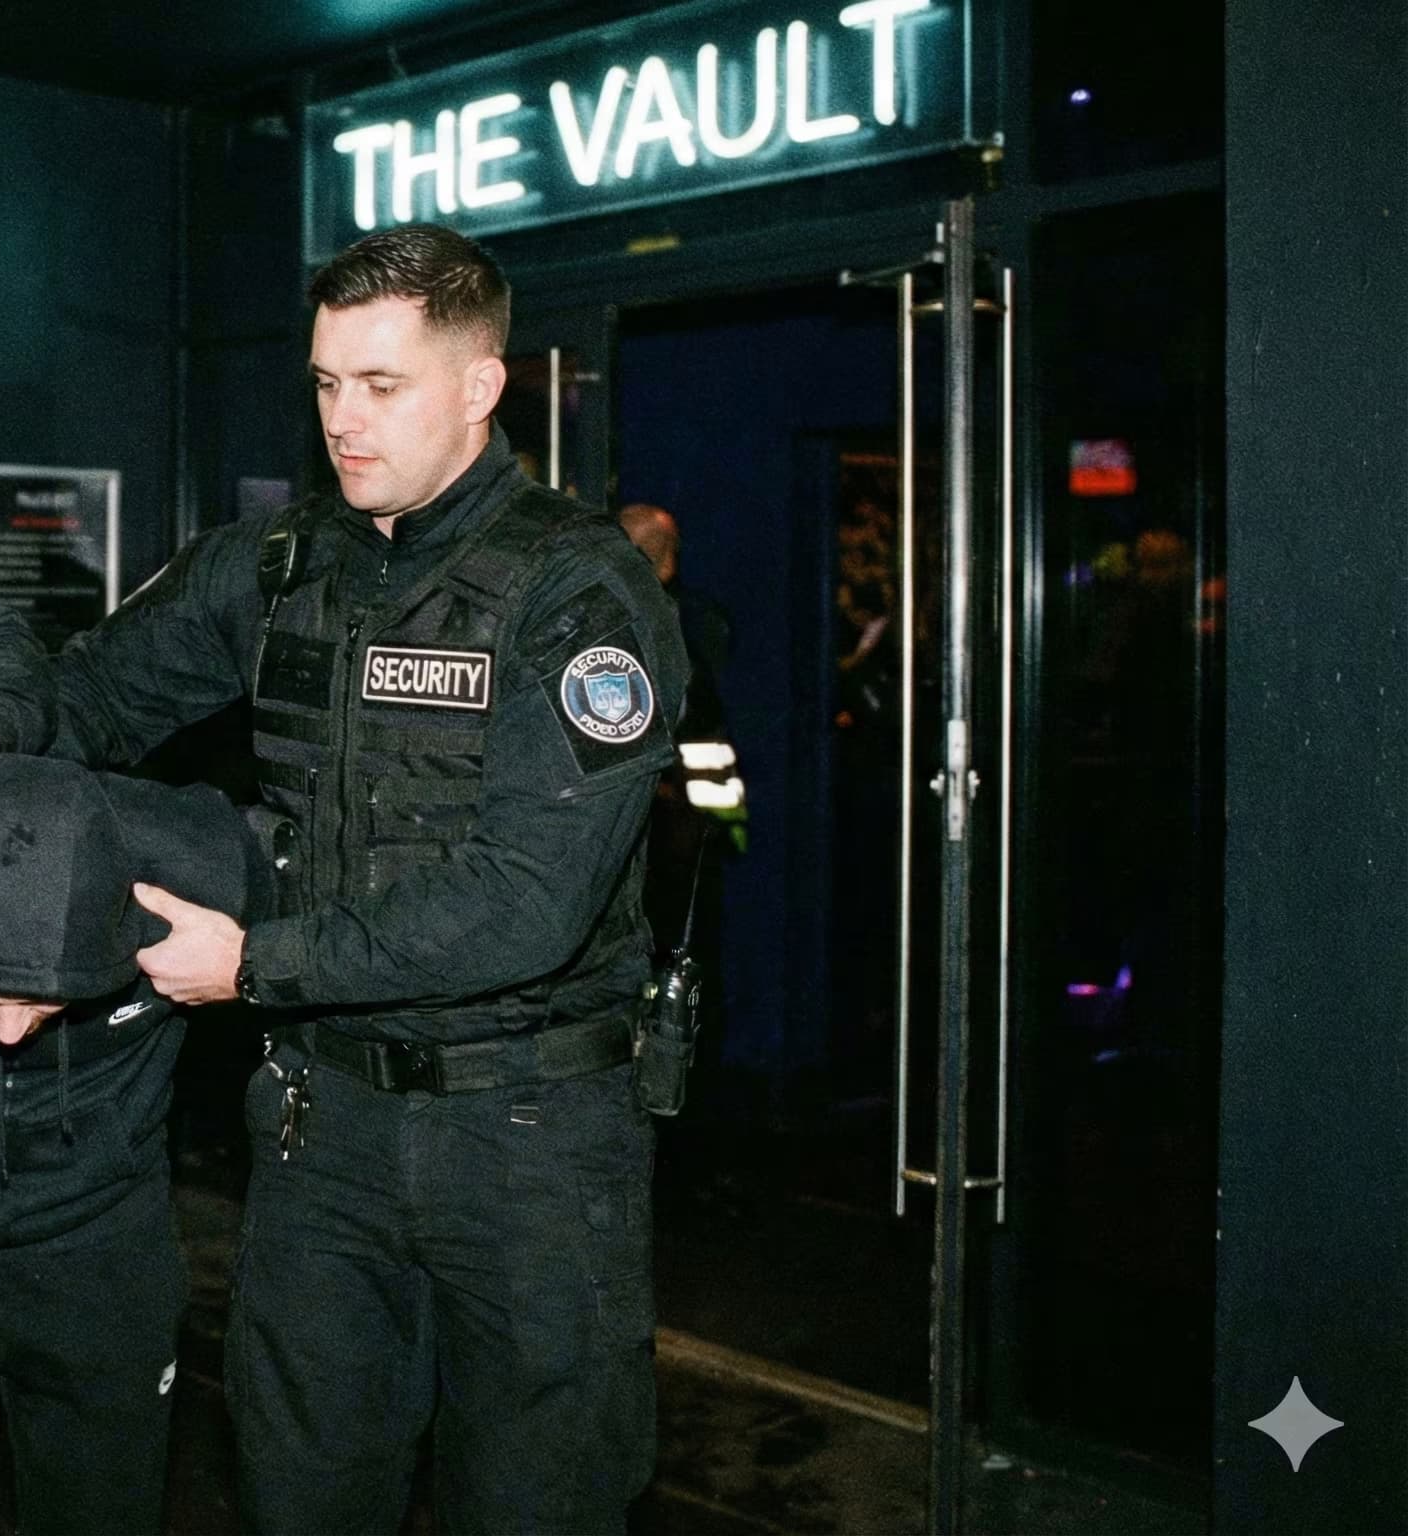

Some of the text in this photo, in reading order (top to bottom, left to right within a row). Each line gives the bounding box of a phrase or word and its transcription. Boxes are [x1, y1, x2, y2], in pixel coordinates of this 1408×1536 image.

[333, 0, 930, 230] THE VAULT
[370, 656, 483, 697] SECURITY
